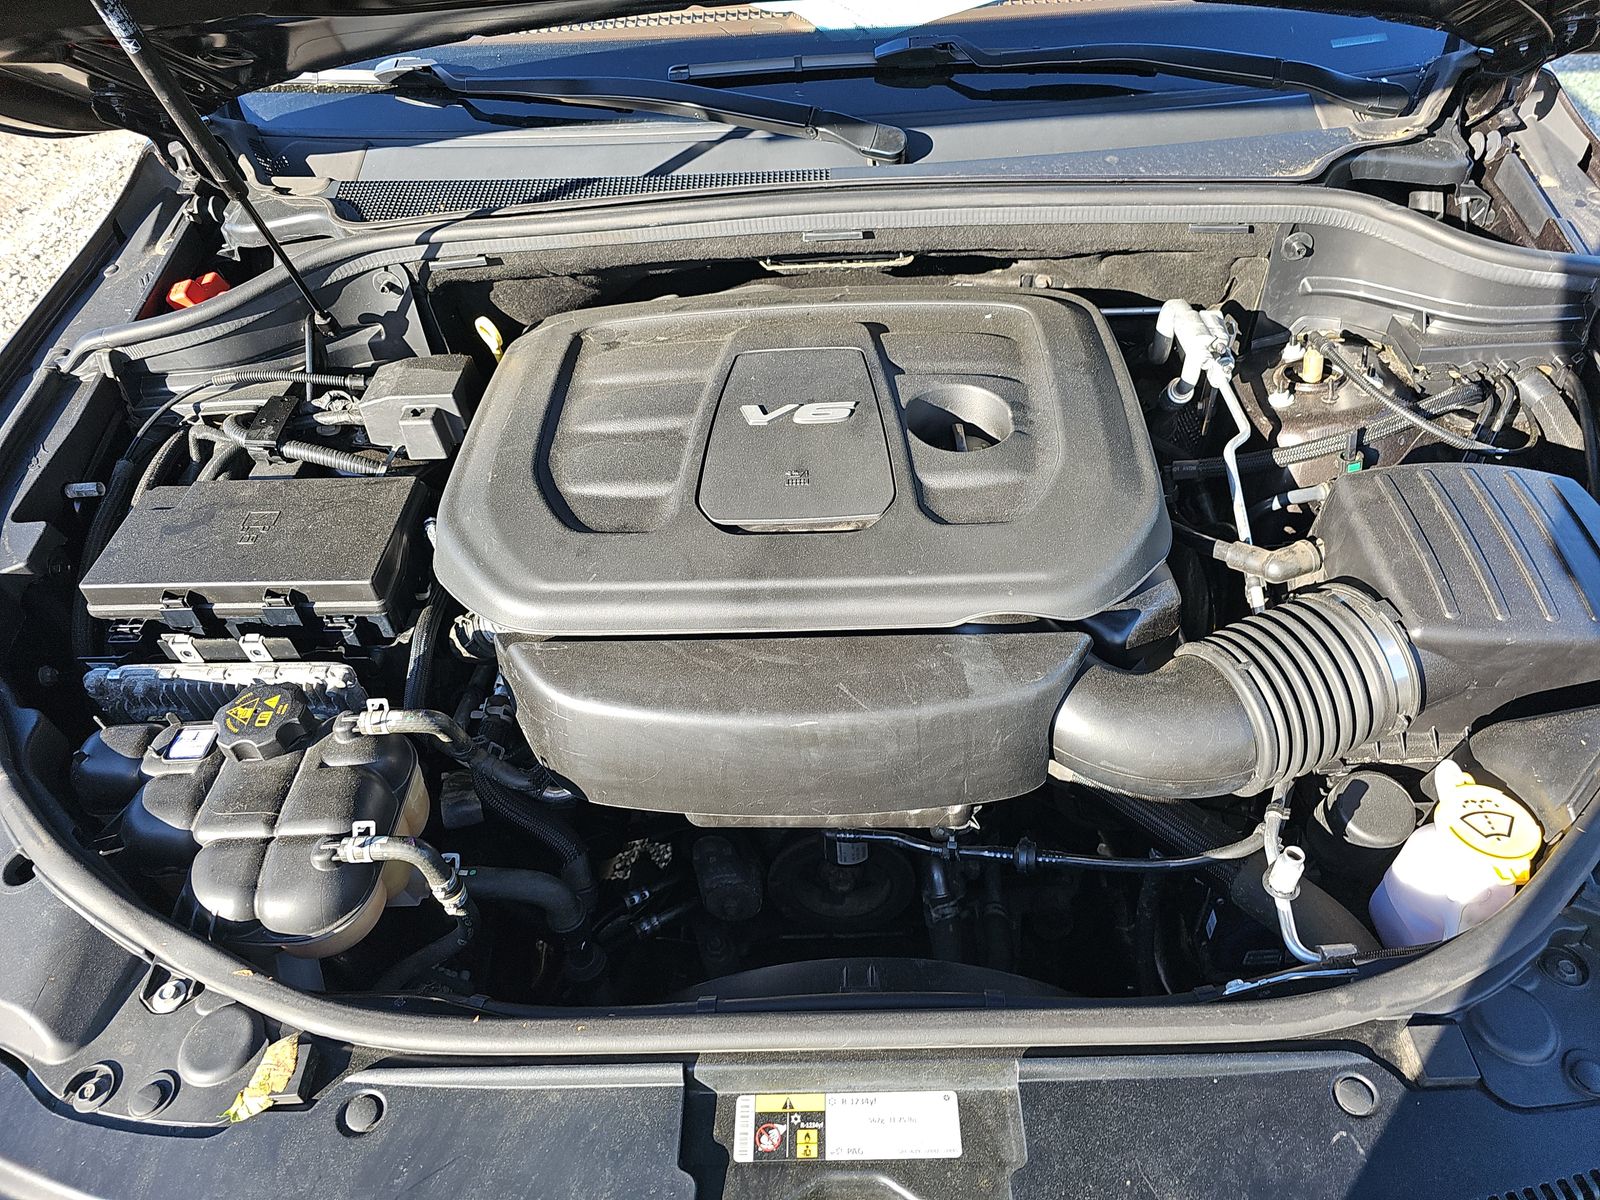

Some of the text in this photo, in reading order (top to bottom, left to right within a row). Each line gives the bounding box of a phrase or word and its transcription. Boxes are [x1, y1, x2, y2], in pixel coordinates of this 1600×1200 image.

[739, 401, 860, 426] V6
[841, 1097, 877, 1106] R1234yf
[847, 1147, 864, 1155] PAG
